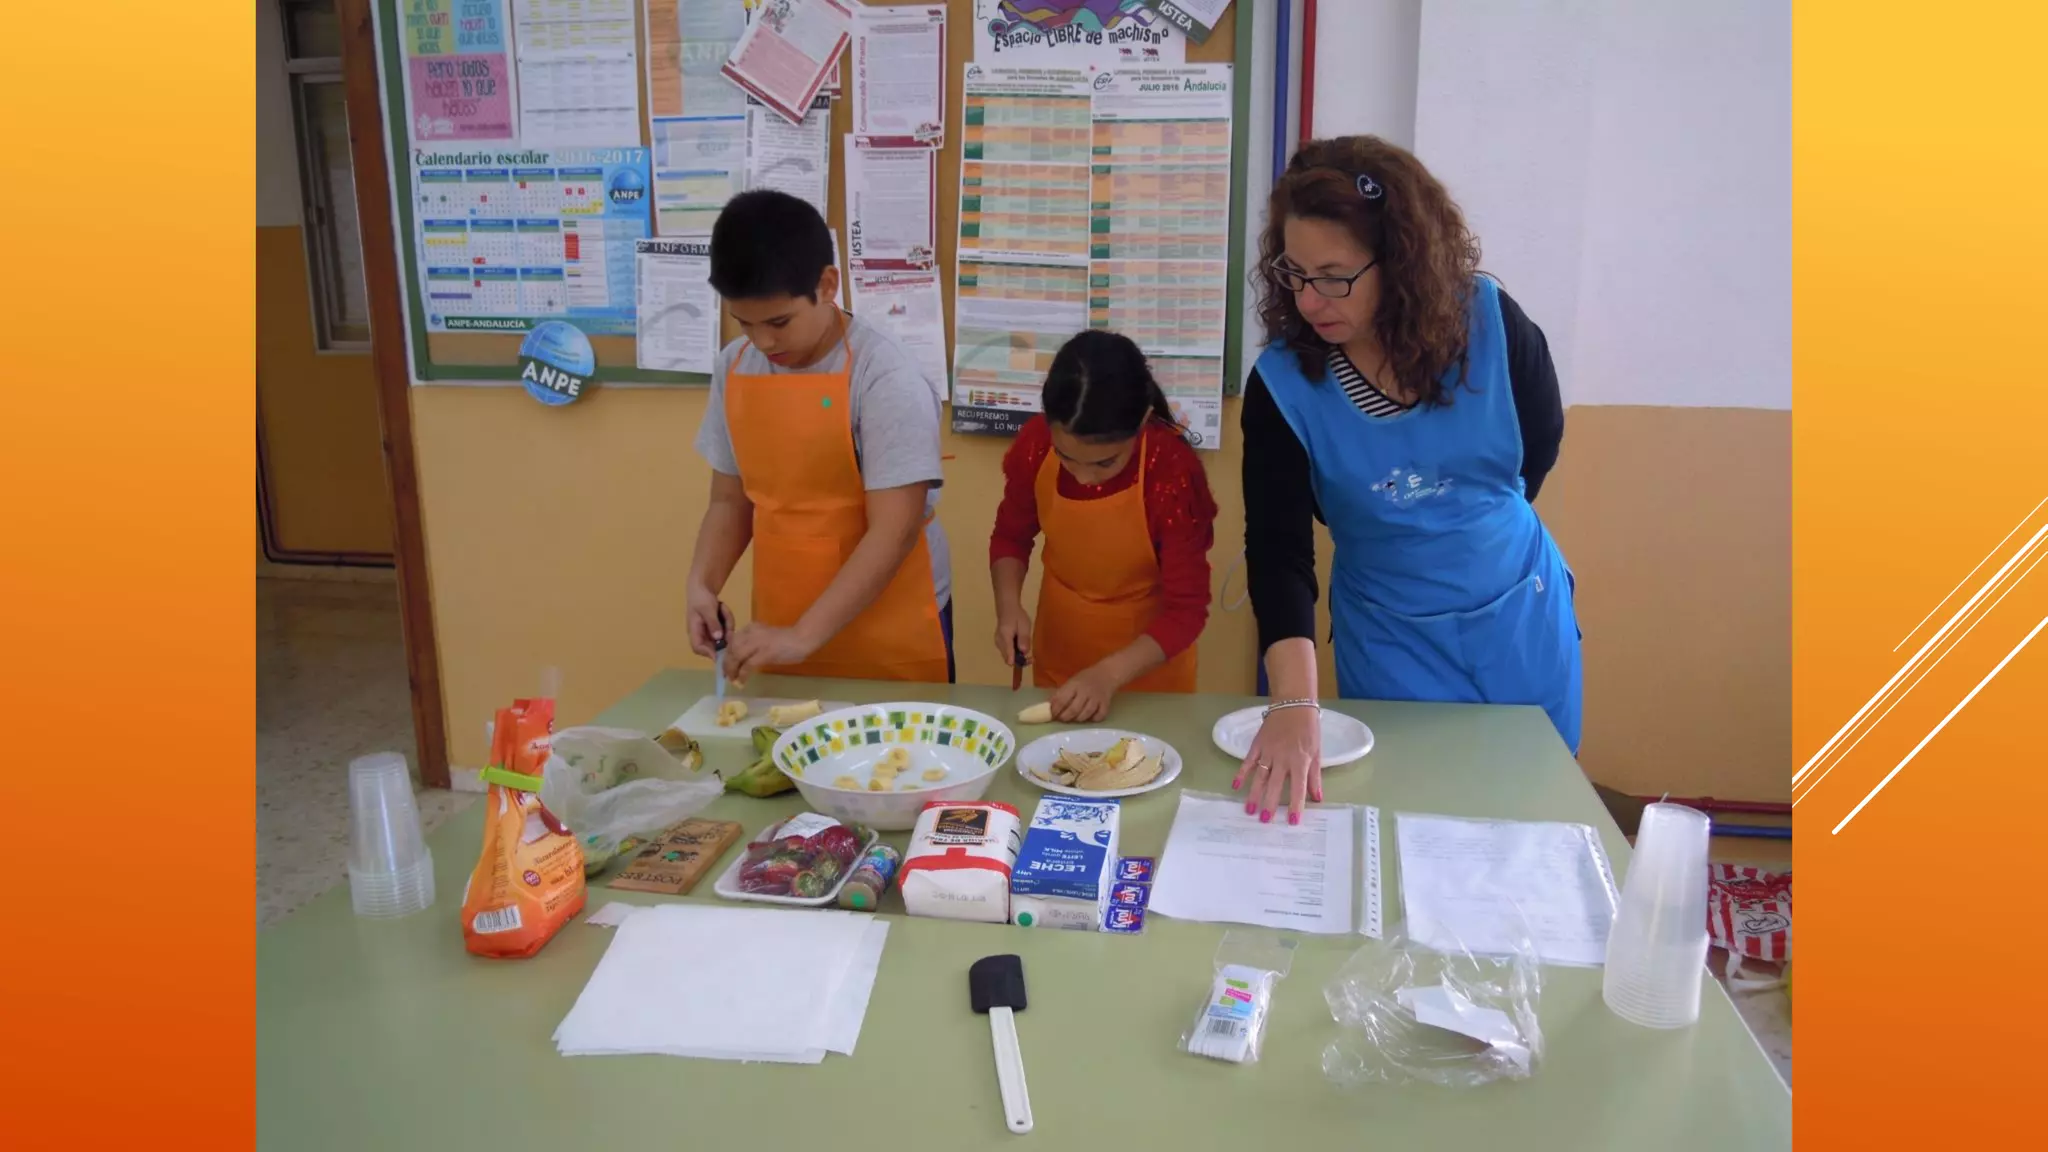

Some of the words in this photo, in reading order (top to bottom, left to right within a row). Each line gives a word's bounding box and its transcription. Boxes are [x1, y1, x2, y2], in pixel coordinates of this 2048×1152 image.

[1159, 0, 1192, 31] USTEA
[994, 32, 1041, 52] Espacio
[1046, 22, 1083, 48] LIBRE
[1086, 32, 1103, 45] de
[1108, 23, 1169, 45] machismo
[860, 68, 866, 78] de
[1138, 83, 1160, 91] JULIO
[1183, 77, 1227, 91] Andalucía
[859, 81, 867, 132] Comunicado
[415, 151, 492, 166] Calendario
[496, 149, 549, 164] escolar
[556, 149, 643, 165] 2016-2017
[612, 190, 641, 201] ANPE
[851, 220, 861, 257] USTEA
[654, 242, 710, 255] INFORM
[521, 361, 582, 396] ANPE
[957, 409, 1010, 421] RECUPEREMOS
[994, 421, 1004, 430] LO
[1030, 861, 1087, 873] LECHE
[615, 872, 683, 885] POSTRES
